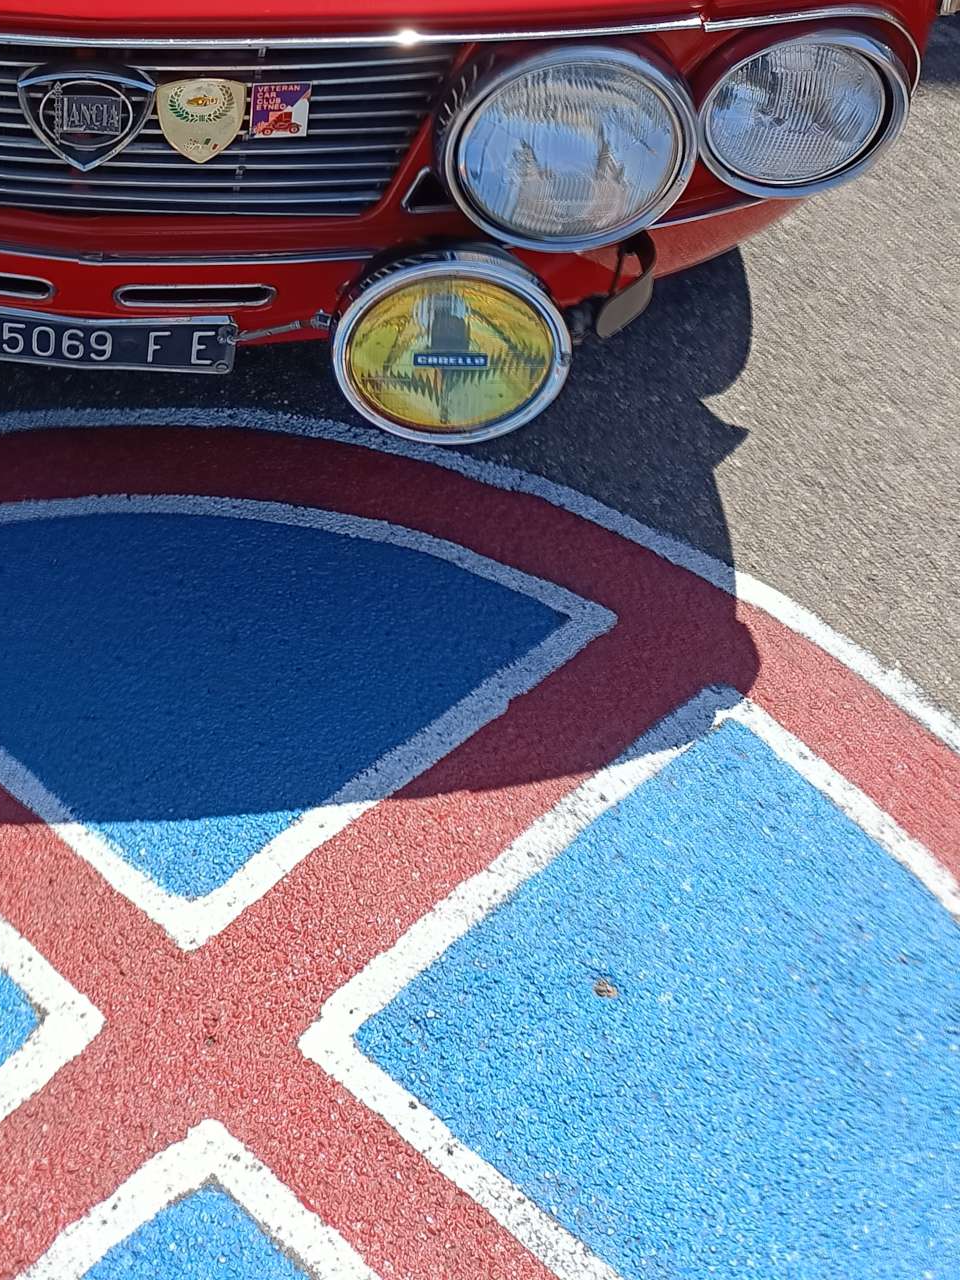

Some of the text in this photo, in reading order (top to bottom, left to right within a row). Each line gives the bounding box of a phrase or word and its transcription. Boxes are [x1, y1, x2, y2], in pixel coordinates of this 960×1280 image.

[257, 84, 301, 92] VETERAN
[257, 91, 277, 99] CAR
[256, 103, 287, 111] ETNEO
[63, 97, 119, 131] LANCIA
